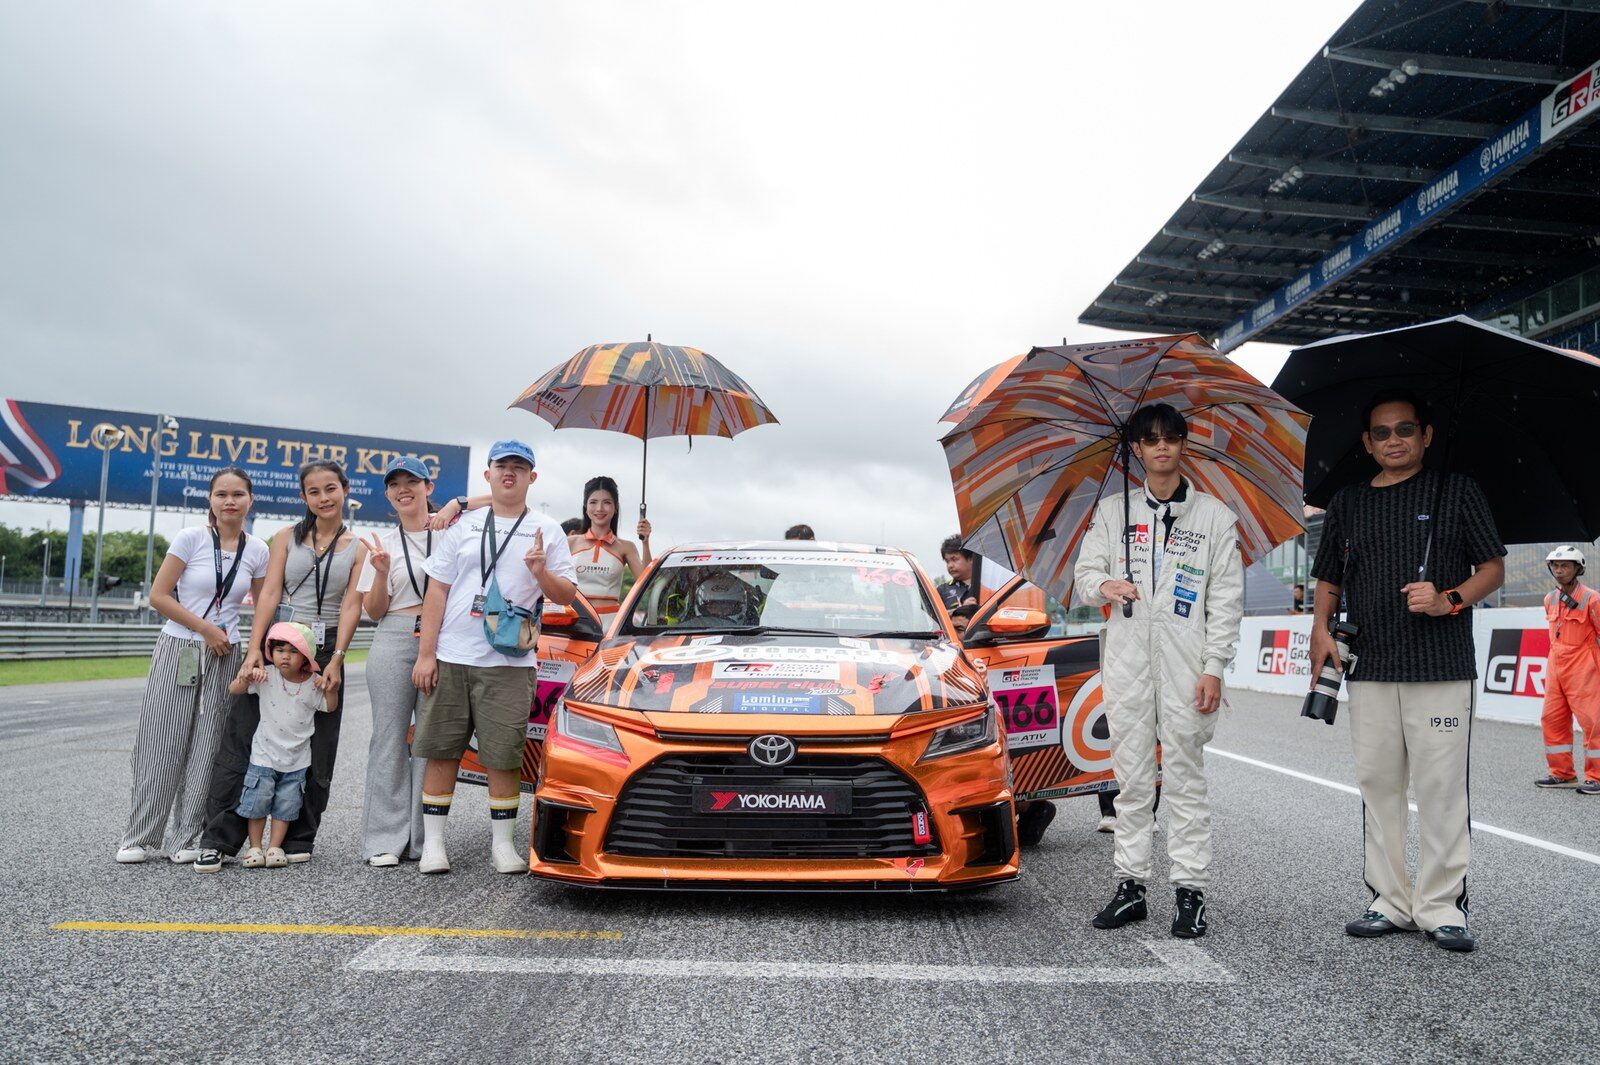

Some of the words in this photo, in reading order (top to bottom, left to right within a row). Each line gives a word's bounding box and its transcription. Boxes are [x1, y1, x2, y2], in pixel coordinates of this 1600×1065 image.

[1552, 86, 1589, 127] GR
[1491, 120, 1530, 161] YAMAHA
[1426, 170, 1459, 205] YAMAHA
[1373, 209, 1402, 241] YAMAHA
[66, 419, 179, 456] LONG
[187, 431, 269, 464] LIVE
[277, 439, 348, 471] THE
[355, 448, 441, 480] KIG
[165, 471, 188, 480] TEAM
[270, 471, 293, 480] FROM
[183, 486, 212, 499] Chan
[1173, 526, 1206, 540] TOYOTA
[1168, 538, 1198, 552] Racing
[854, 567, 914, 586] 166
[1292, 632, 1311, 645] TOY
[742, 647, 889, 658] COMPACT
[1290, 648, 1311, 660] GAZ
[1258, 647, 1288, 674] GR
[1288, 662, 1311, 675] Raci
[1486, 655, 1548, 695] GR
[1002, 674, 1020, 682] GR
[741, 694, 793, 704] Lamina
[997, 691, 1054, 730] 166
[1020, 733, 1047, 742] ATIV
[738, 794, 826, 808] YOKOHAMA
